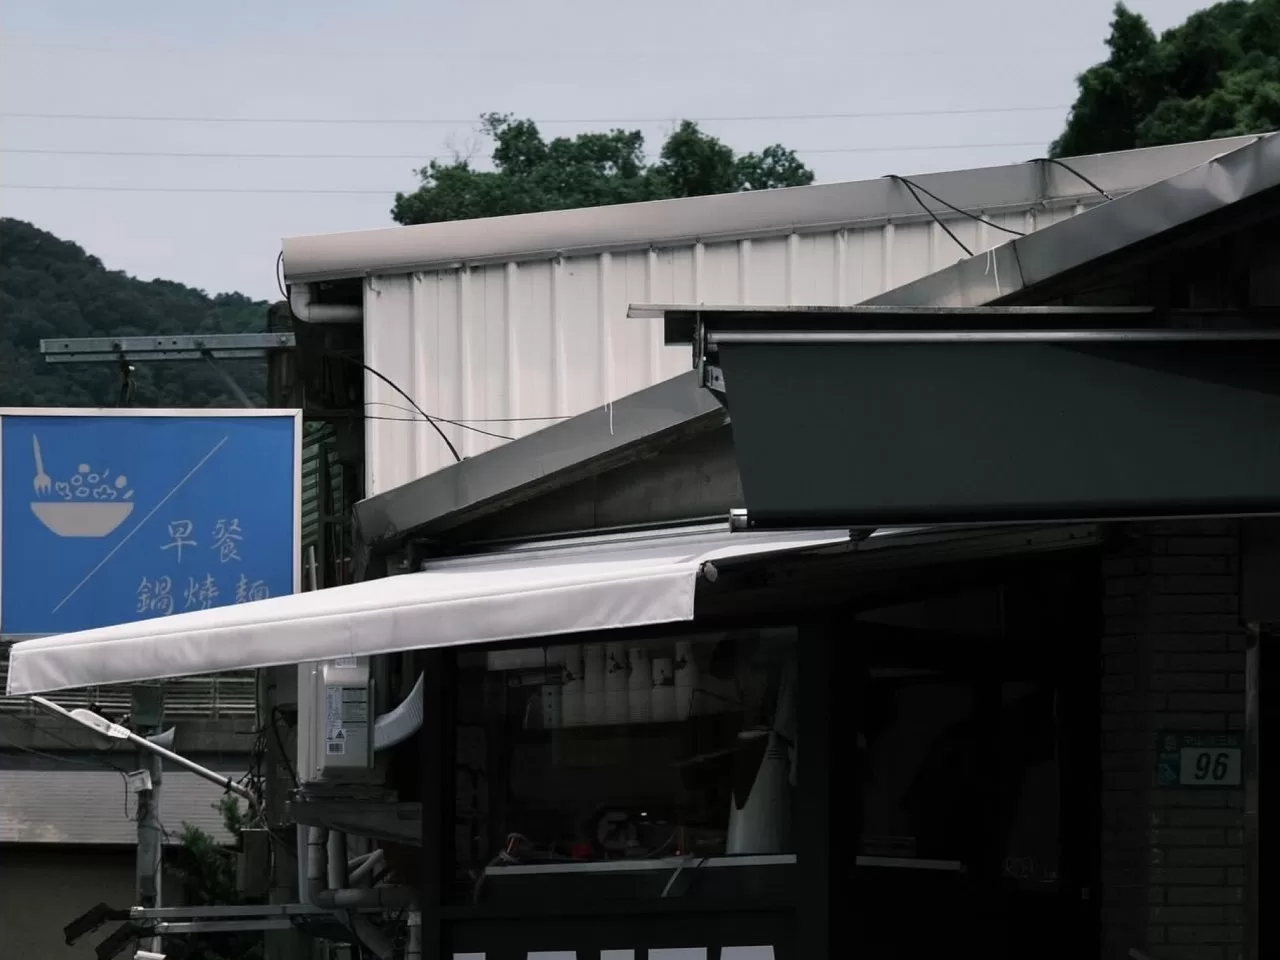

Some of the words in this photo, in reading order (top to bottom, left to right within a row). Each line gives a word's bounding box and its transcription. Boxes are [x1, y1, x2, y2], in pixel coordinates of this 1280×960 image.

[159, 517, 245, 565] 早餐
[135, 572, 270, 615] 鍋燒麵
[1194, 752, 1229, 781] 96
